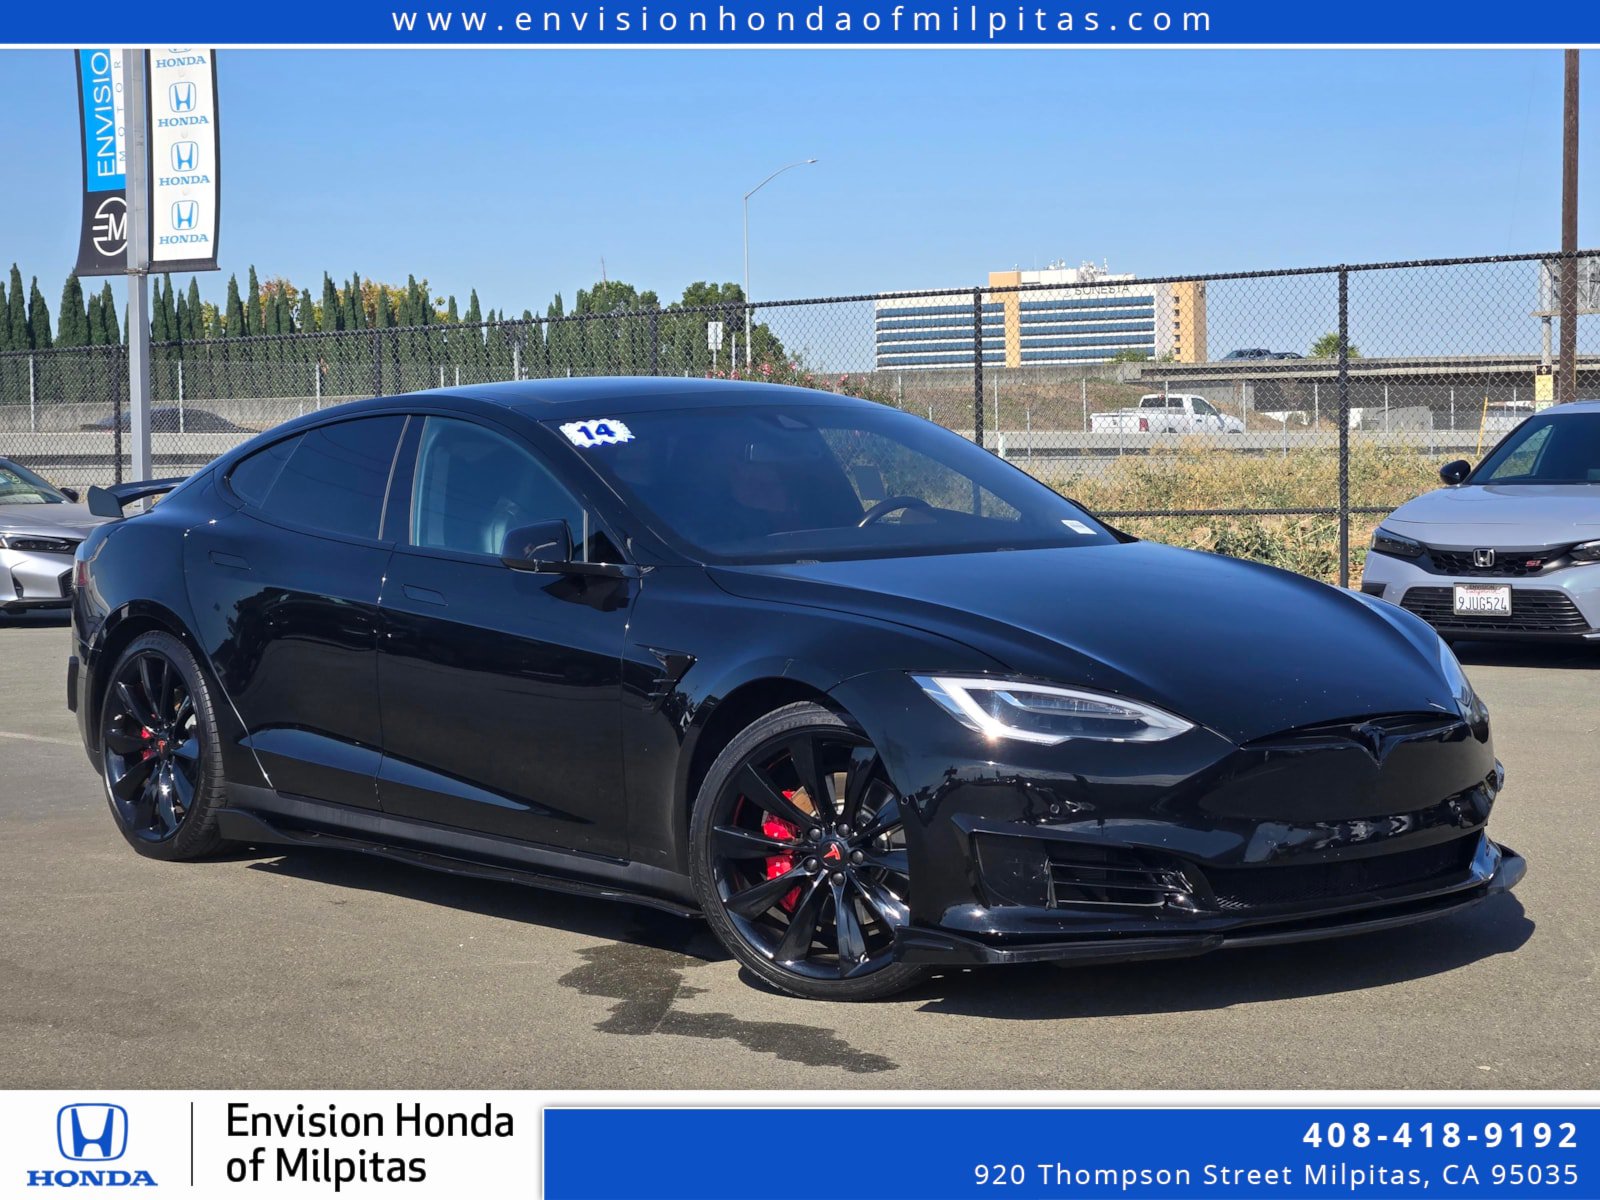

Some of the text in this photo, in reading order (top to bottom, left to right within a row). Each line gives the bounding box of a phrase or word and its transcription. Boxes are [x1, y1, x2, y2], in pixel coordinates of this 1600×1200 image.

[155, 55, 207, 69] HONDA
[157, 115, 209, 128] HONDA
[158, 175, 210, 187] HONDA
[158, 233, 209, 245] HONDA
[577, 424, 616, 439] 14
[1458, 596, 1507, 611] 9JUG524
